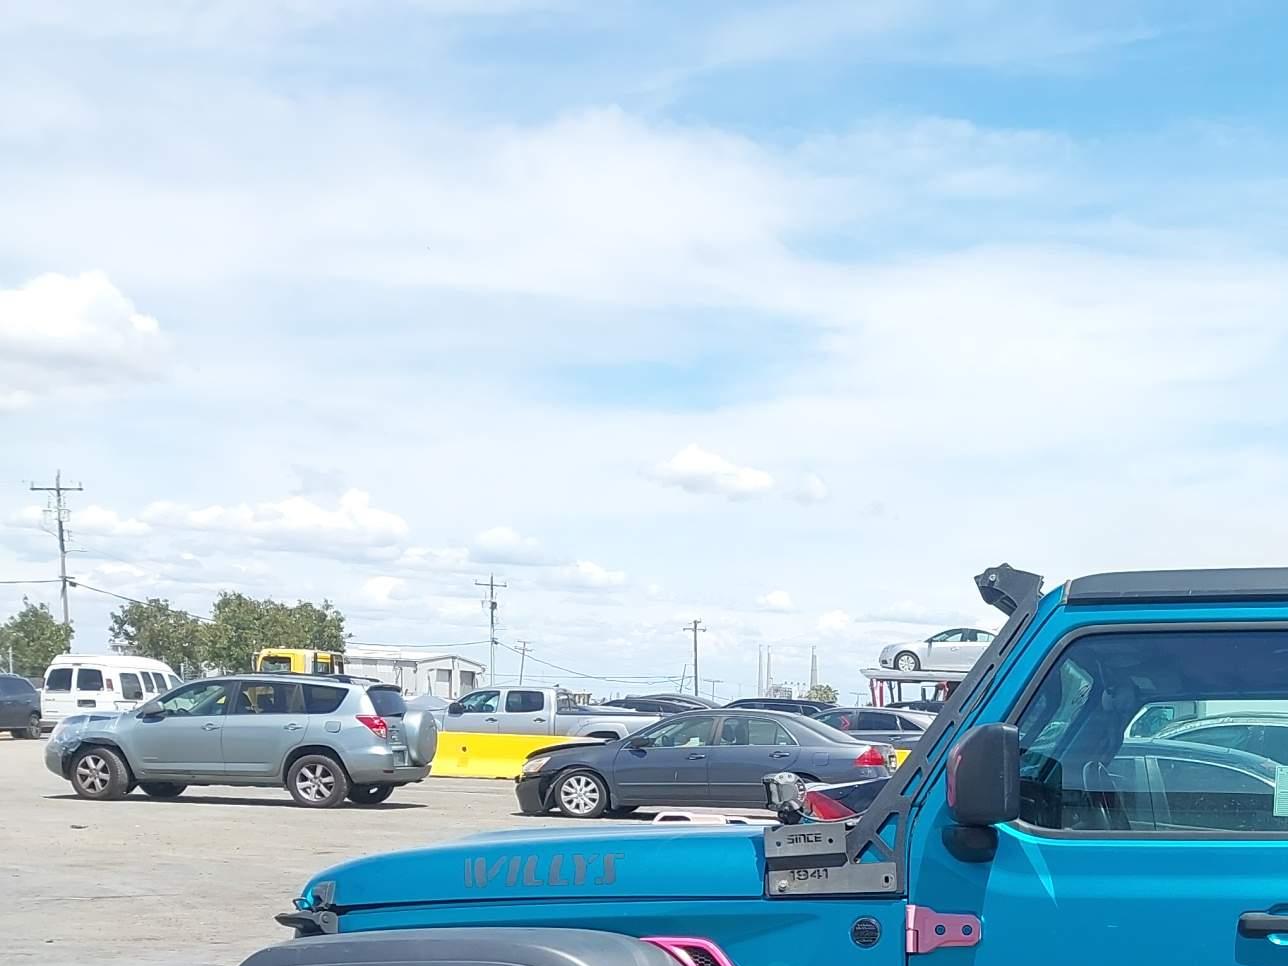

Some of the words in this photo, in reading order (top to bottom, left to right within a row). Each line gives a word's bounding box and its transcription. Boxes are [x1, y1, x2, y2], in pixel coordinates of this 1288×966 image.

[786, 833, 822, 845] SINCE
[464, 853, 624, 888] WILLYS
[790, 868, 828, 881] 1941
